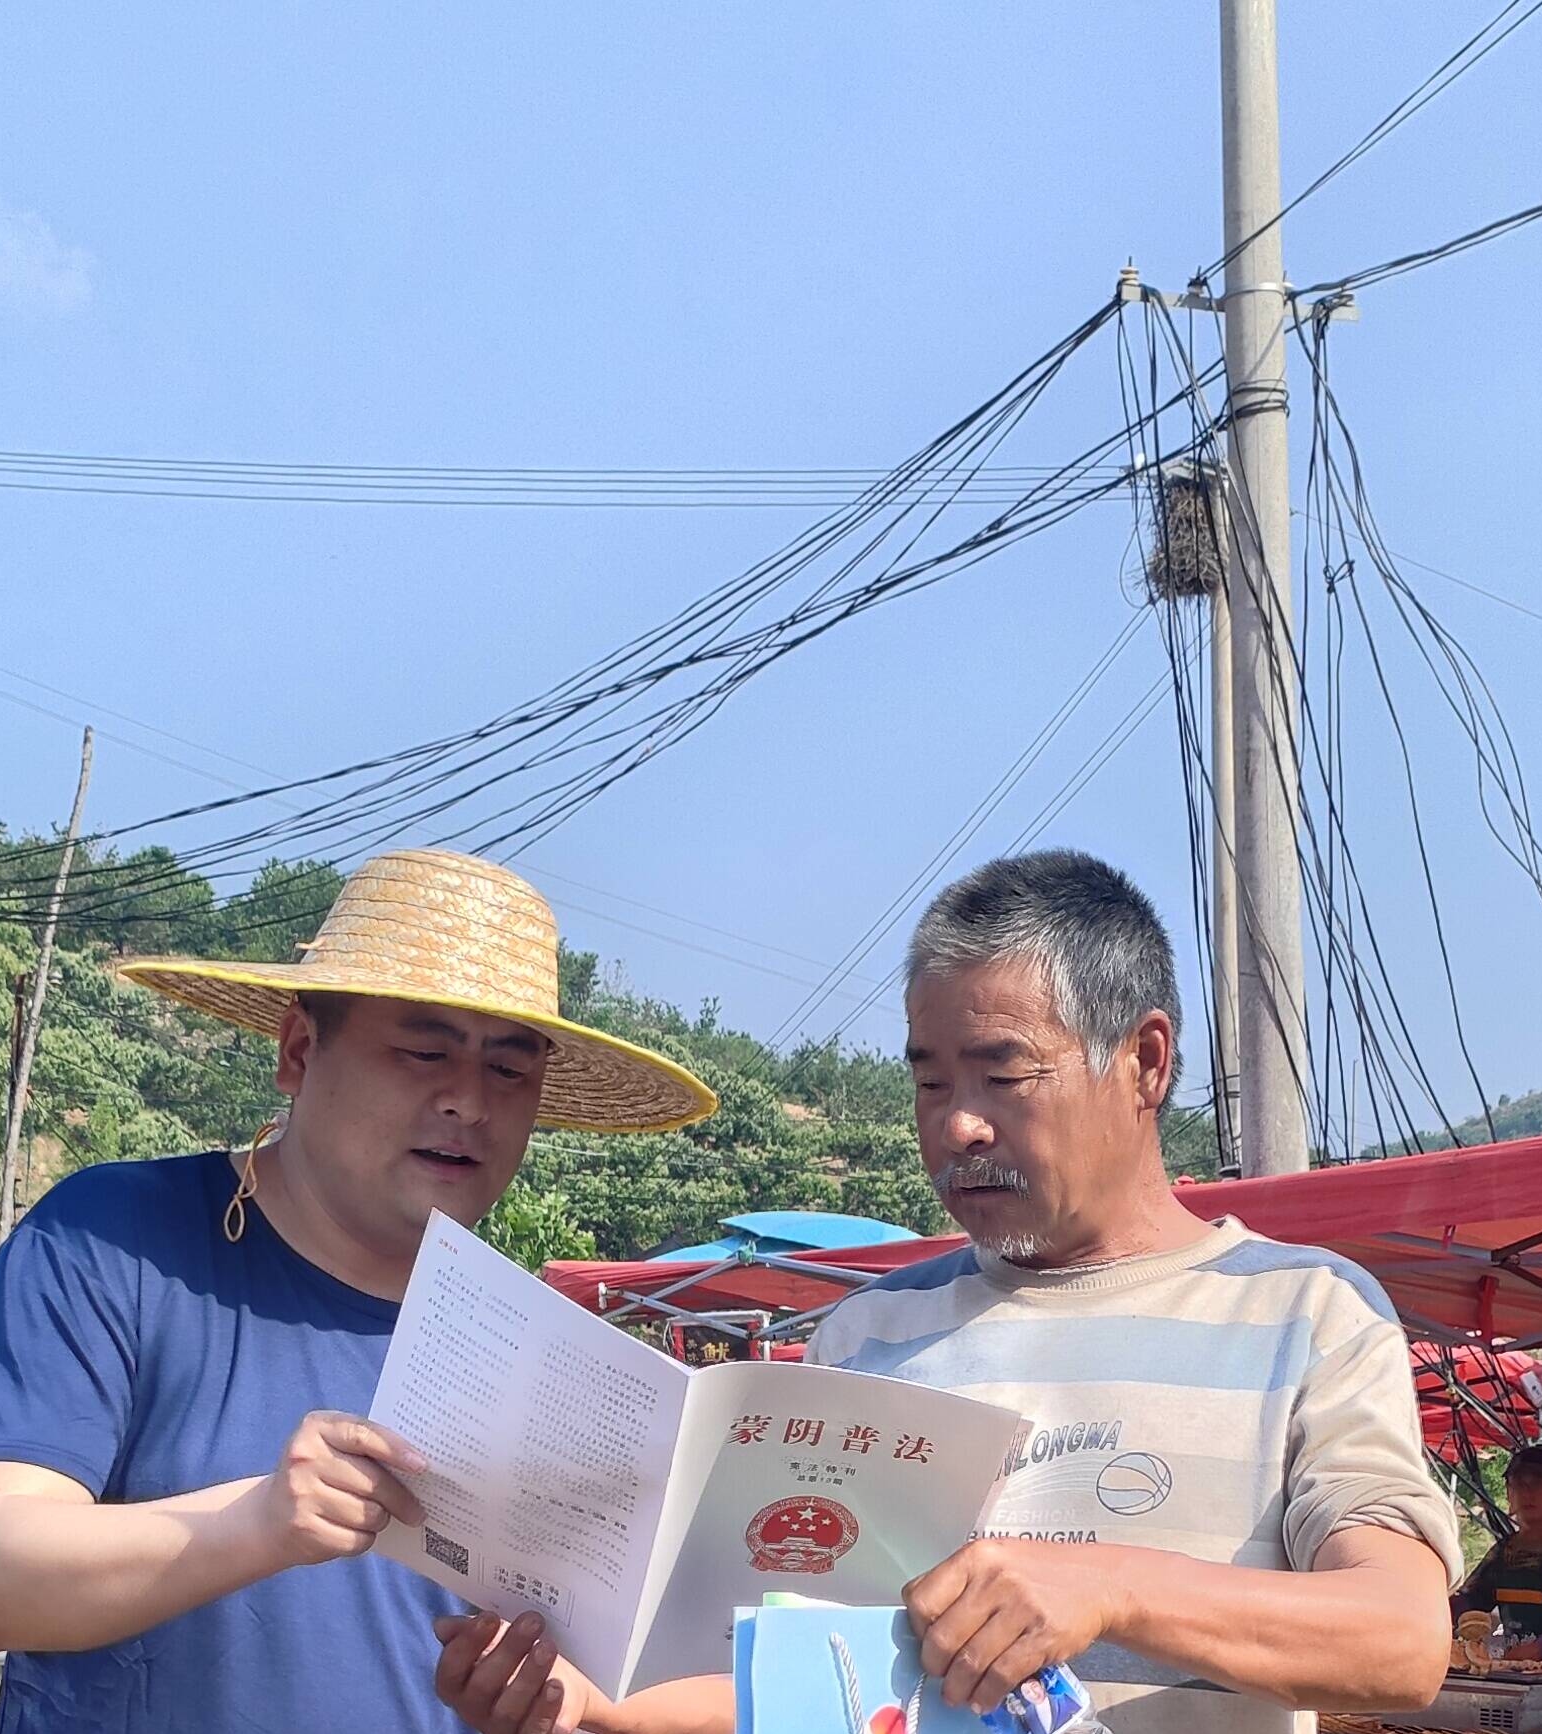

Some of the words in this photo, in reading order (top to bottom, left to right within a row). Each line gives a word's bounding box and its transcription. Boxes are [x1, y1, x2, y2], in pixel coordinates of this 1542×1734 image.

[727, 1414, 936, 1464] 蒙阴普法
[995, 1508, 1077, 1524] FASHION
